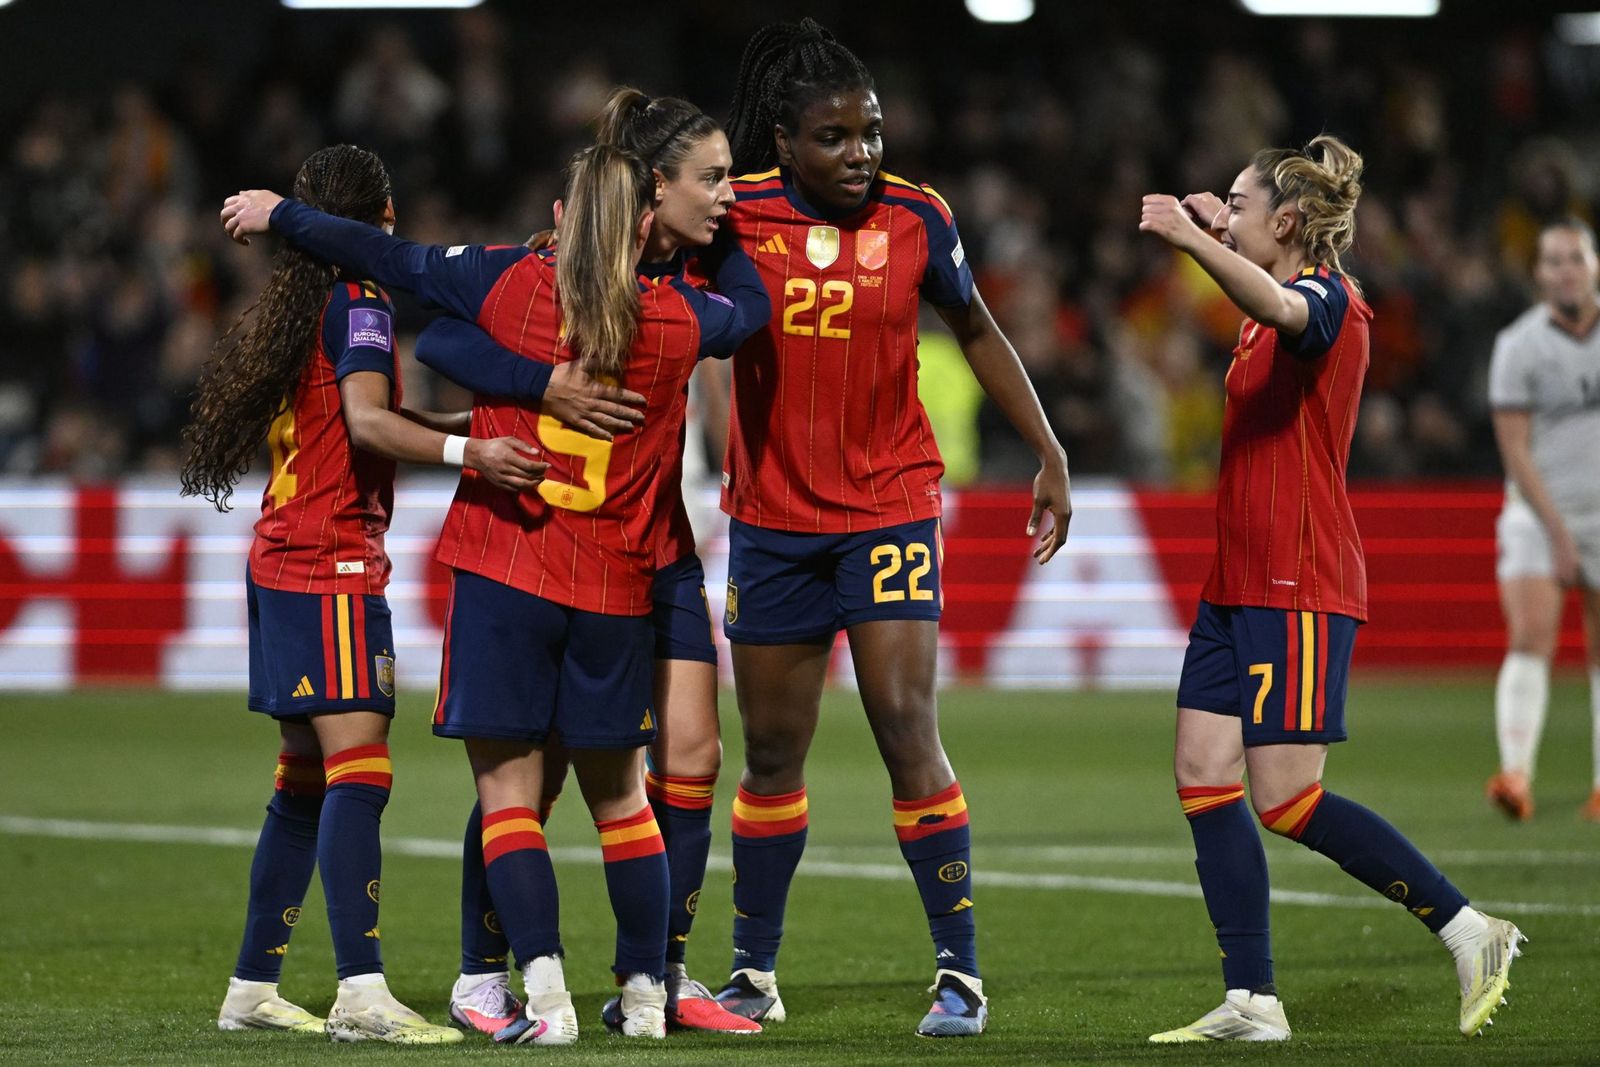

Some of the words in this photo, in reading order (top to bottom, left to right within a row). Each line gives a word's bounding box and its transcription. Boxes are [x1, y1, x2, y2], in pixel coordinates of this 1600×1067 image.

[353, 332, 387, 340] EUROPEAN
[783, 277, 854, 339] 22
[353, 336, 387, 346] QUALIFIERS
[870, 542, 934, 604] 22
[1248, 663, 1273, 725] 7
